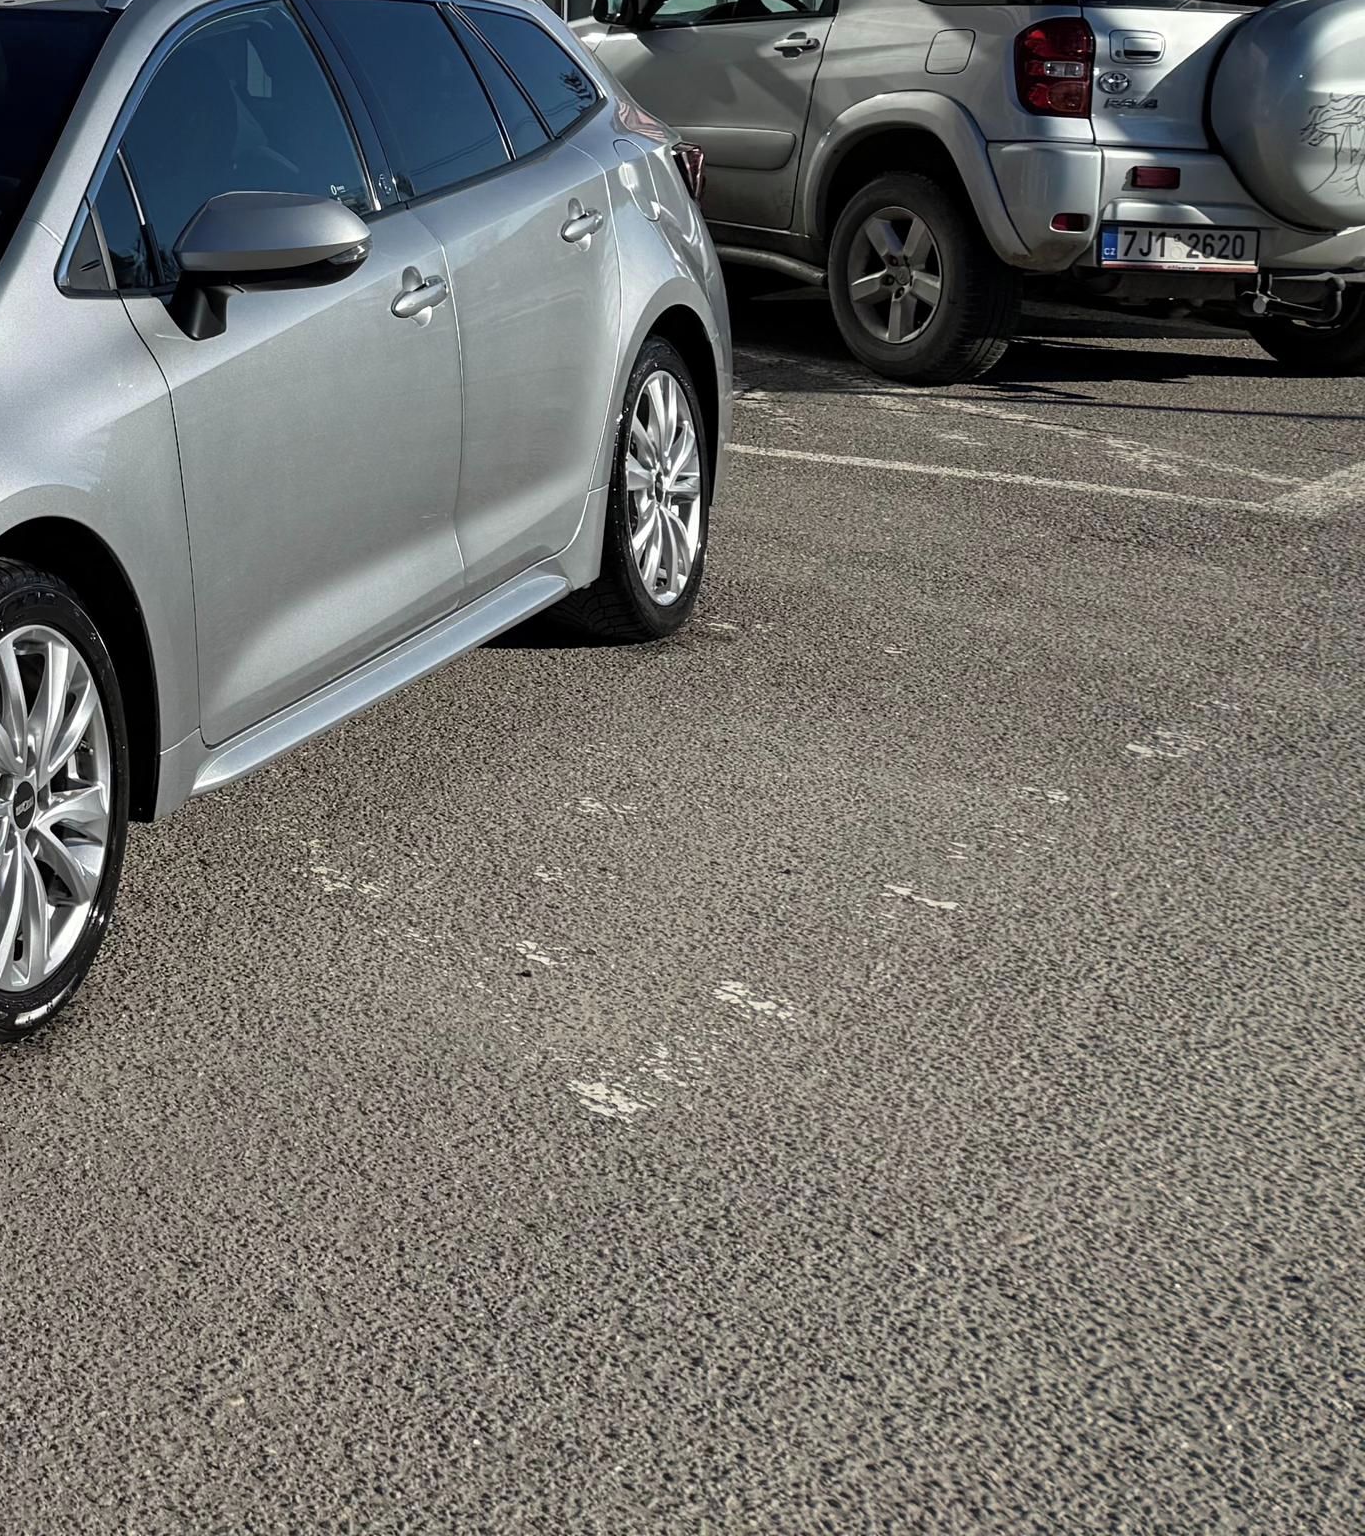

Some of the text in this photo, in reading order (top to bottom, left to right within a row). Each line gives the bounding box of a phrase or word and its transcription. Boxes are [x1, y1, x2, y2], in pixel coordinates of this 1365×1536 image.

[1103, 247, 1117, 256] CZ
[1123, 230, 1245, 260] 7J1 2620
